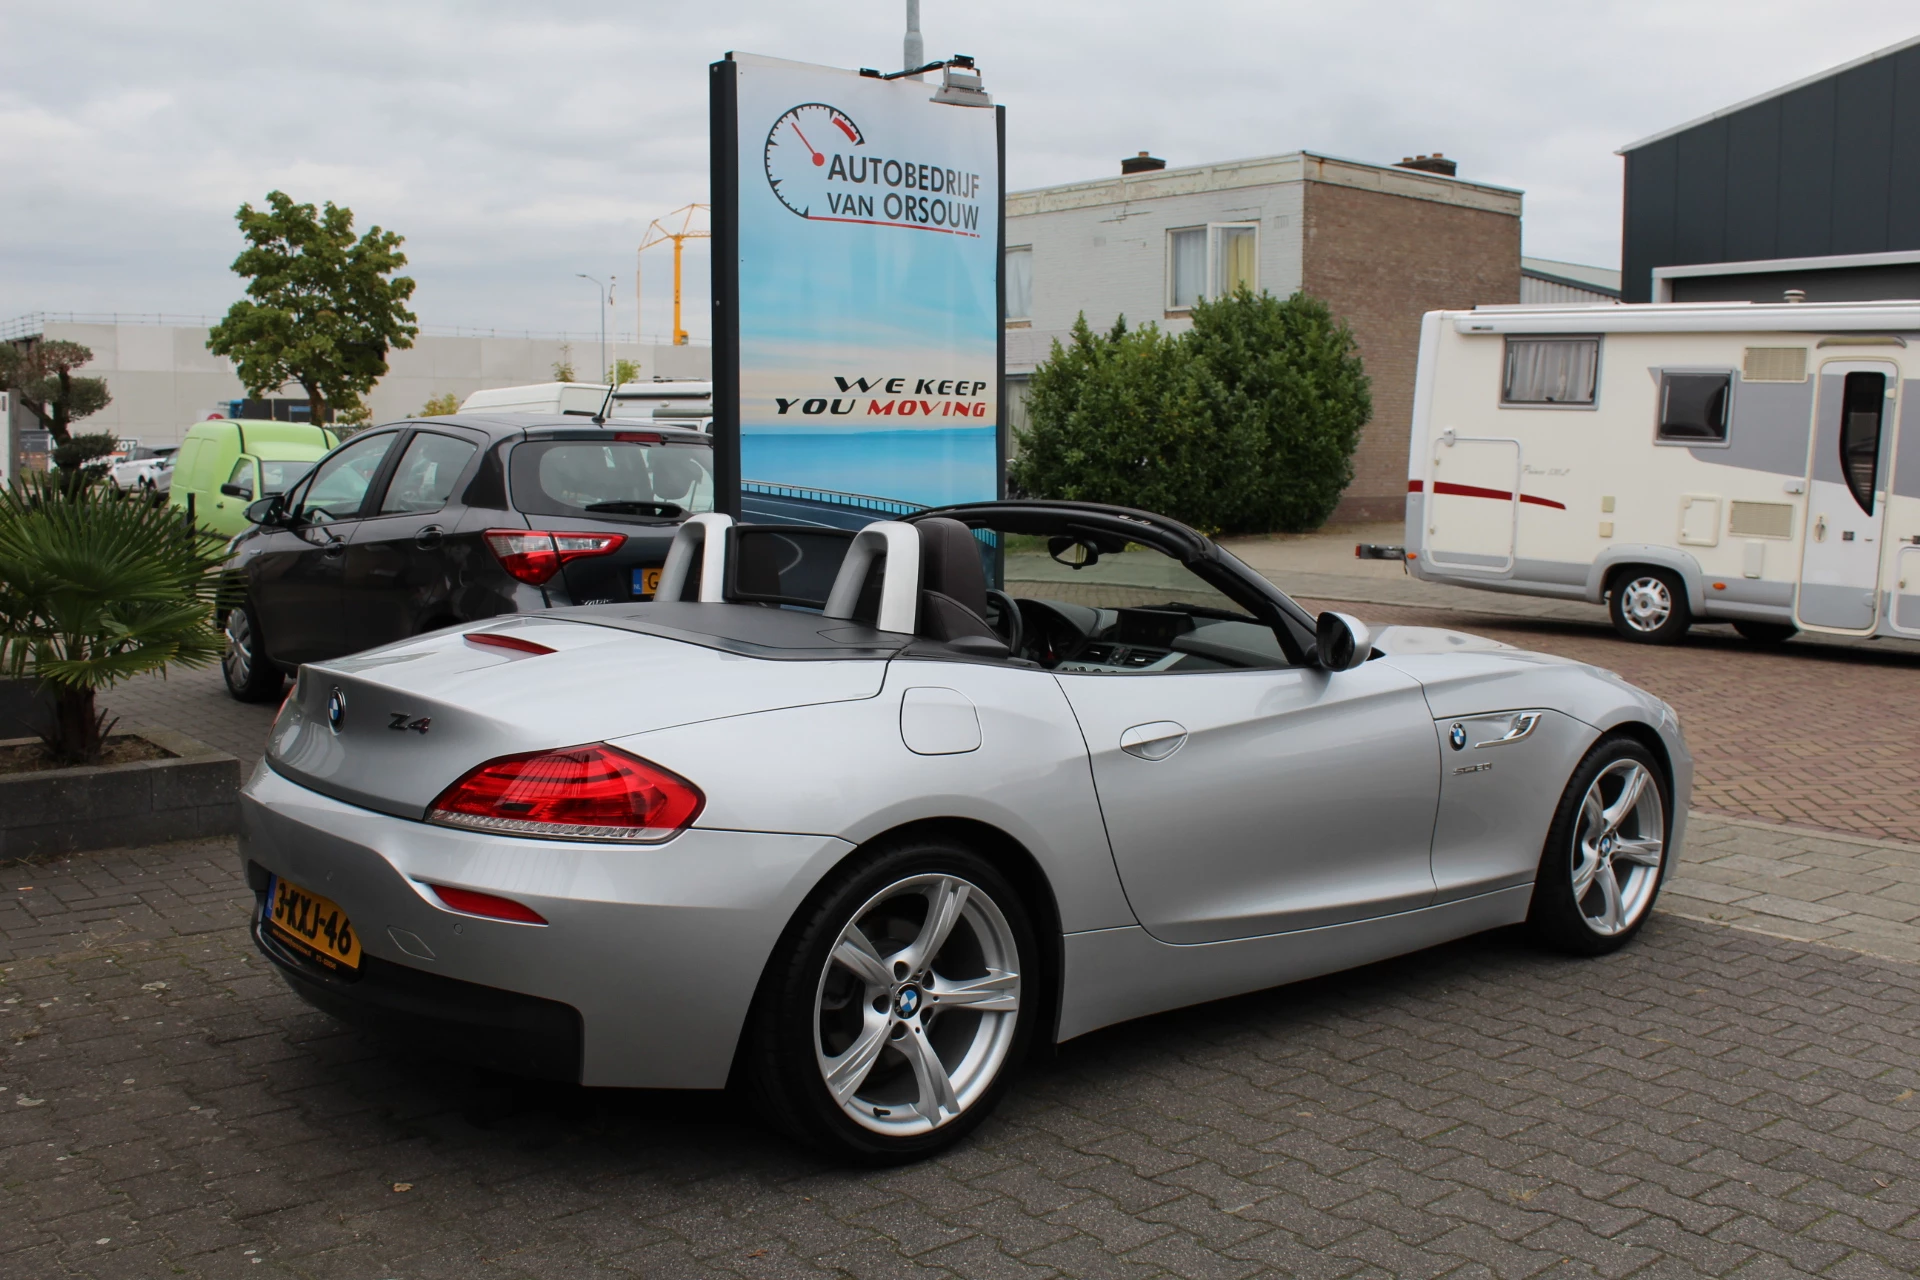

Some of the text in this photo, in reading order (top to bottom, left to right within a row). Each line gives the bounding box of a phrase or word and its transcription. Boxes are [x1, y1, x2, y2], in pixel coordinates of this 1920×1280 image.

[827, 153, 980, 199] AUTOBEDRIJF
[827, 192, 980, 231] VAN ORSOUW
[834, 376, 987, 397] WE KEEP
[775, 398, 987, 418] YOU MOVING
[388, 711, 432, 735] Z4
[275, 882, 352, 956] 3-KXJ-46
